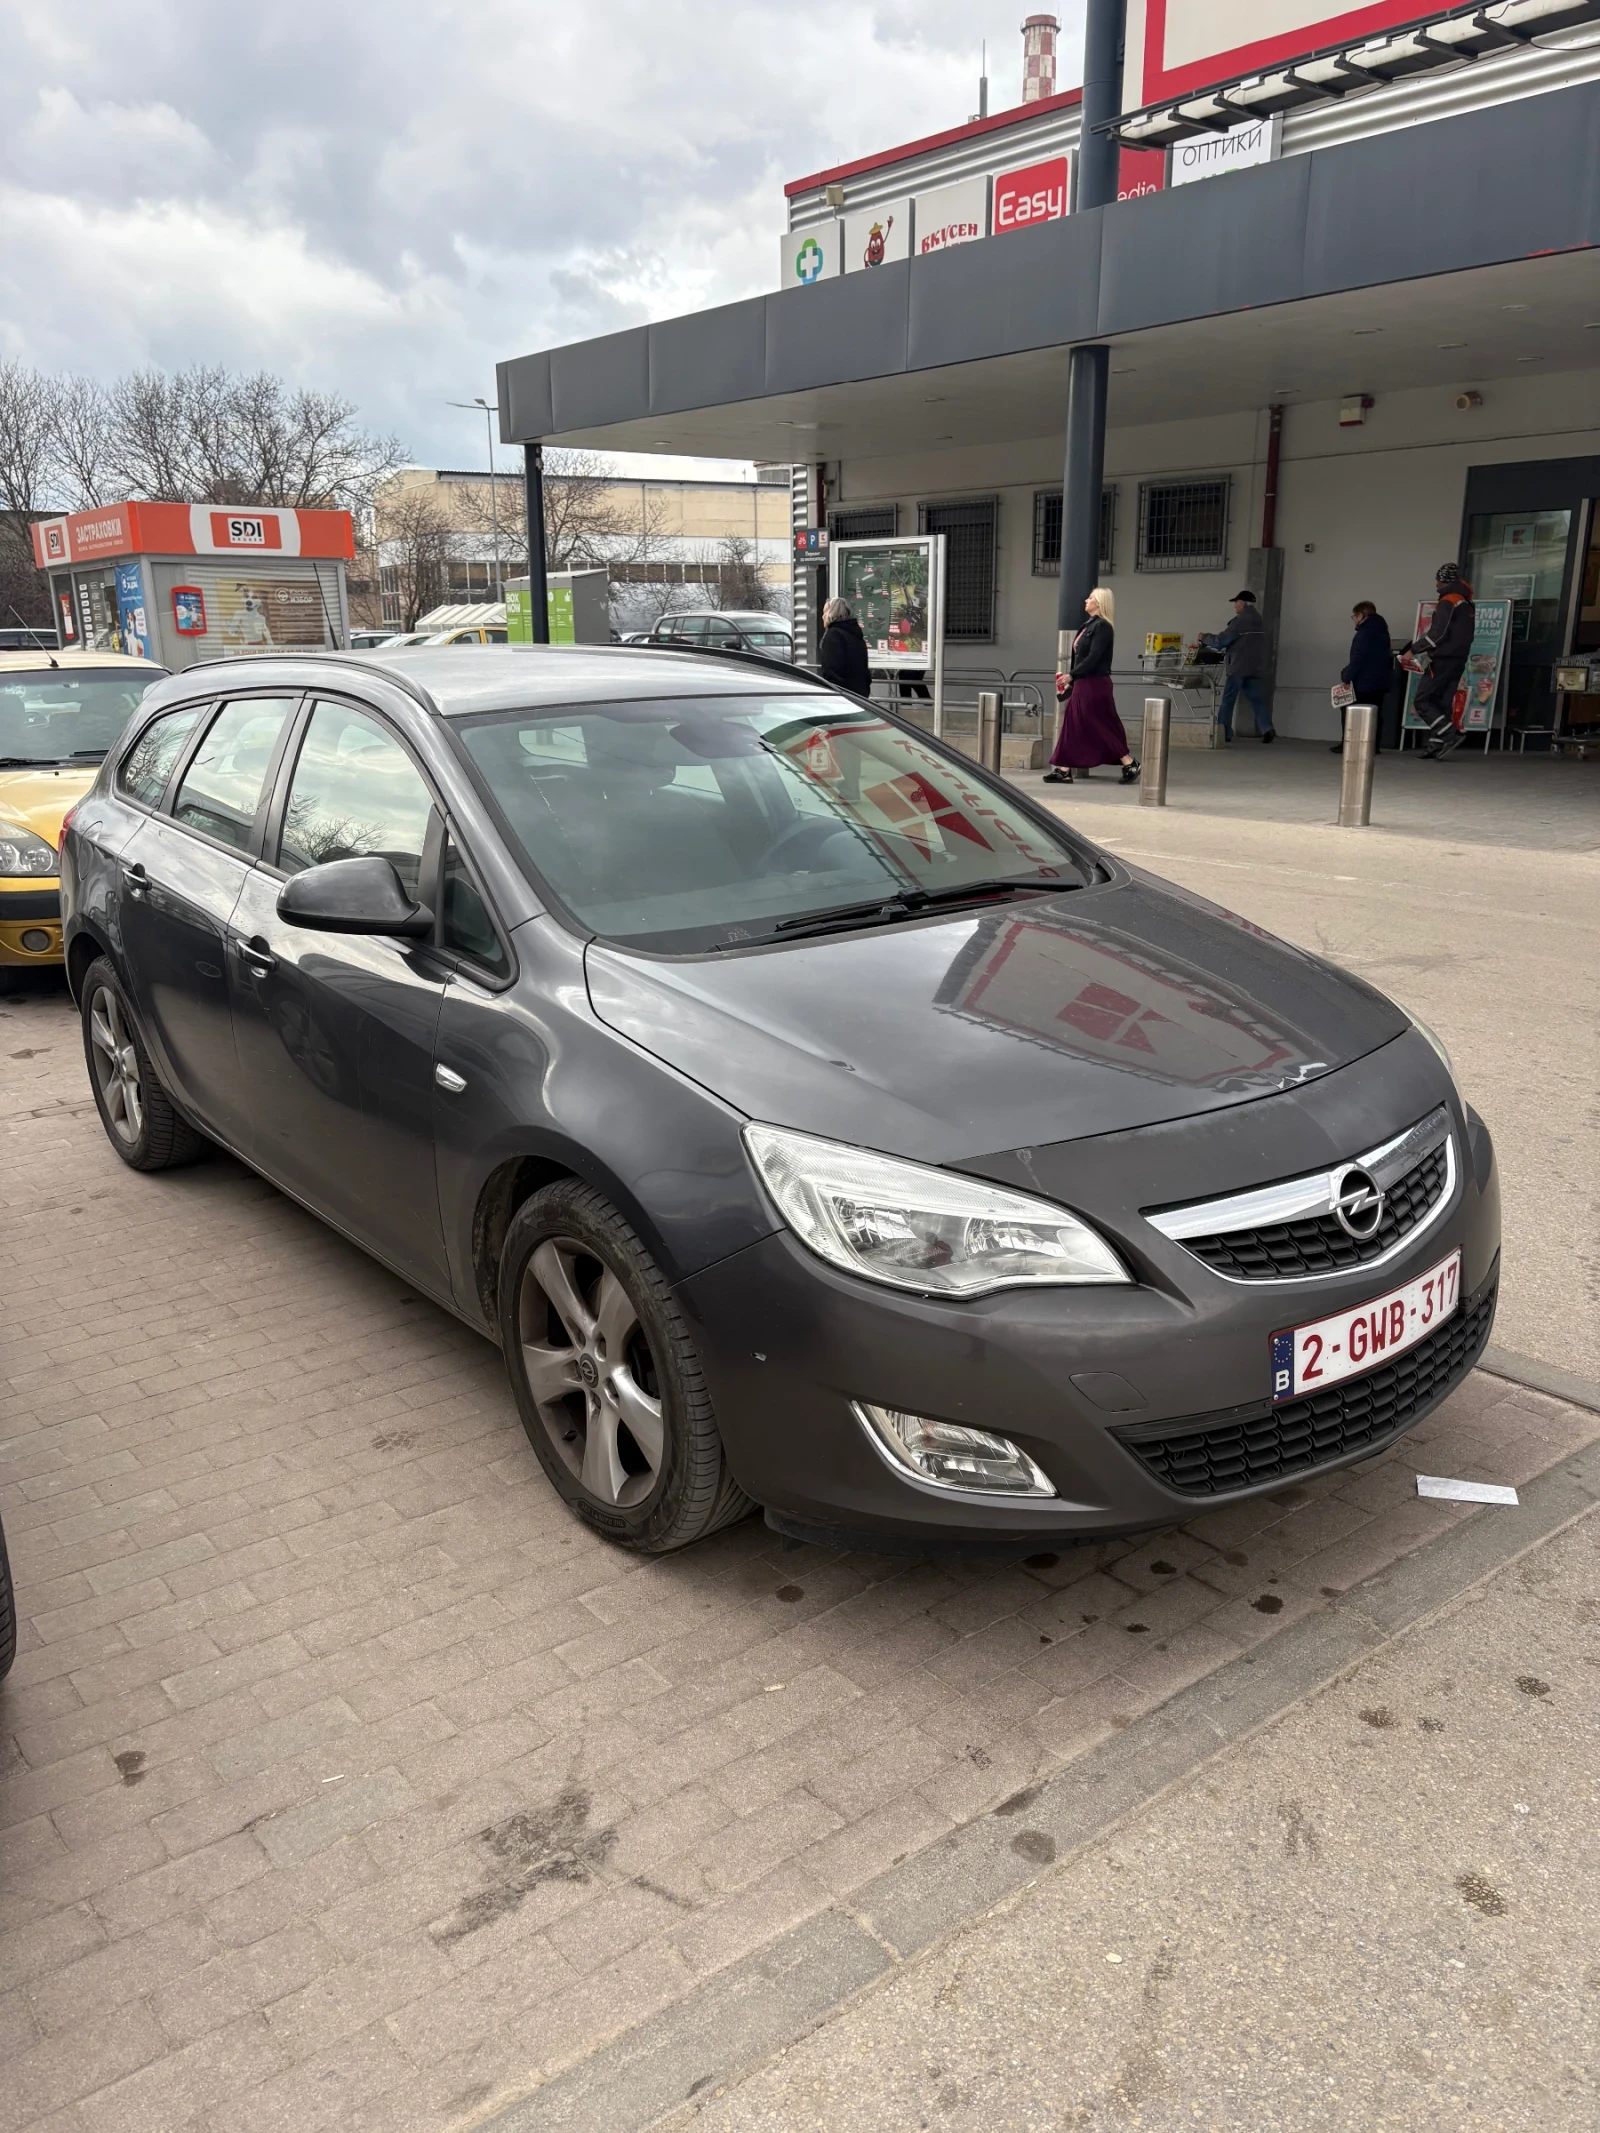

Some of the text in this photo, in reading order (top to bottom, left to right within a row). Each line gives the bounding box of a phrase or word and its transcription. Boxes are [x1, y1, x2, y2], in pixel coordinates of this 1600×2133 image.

[1183, 128, 1262, 166] ОПТИКИ
[999, 186, 1062, 226] Easy
[921, 223, 978, 254] ВКУСЕН
[76, 518, 122, 544] ЗАСТРАХОВКИ
[231, 520, 262, 537] SDI
[506, 593, 519, 603] BOX
[507, 603, 520, 613] NOW
[1301, 1261, 1458, 1382] 2-GWB-317
[1275, 1369, 1290, 1392] B
